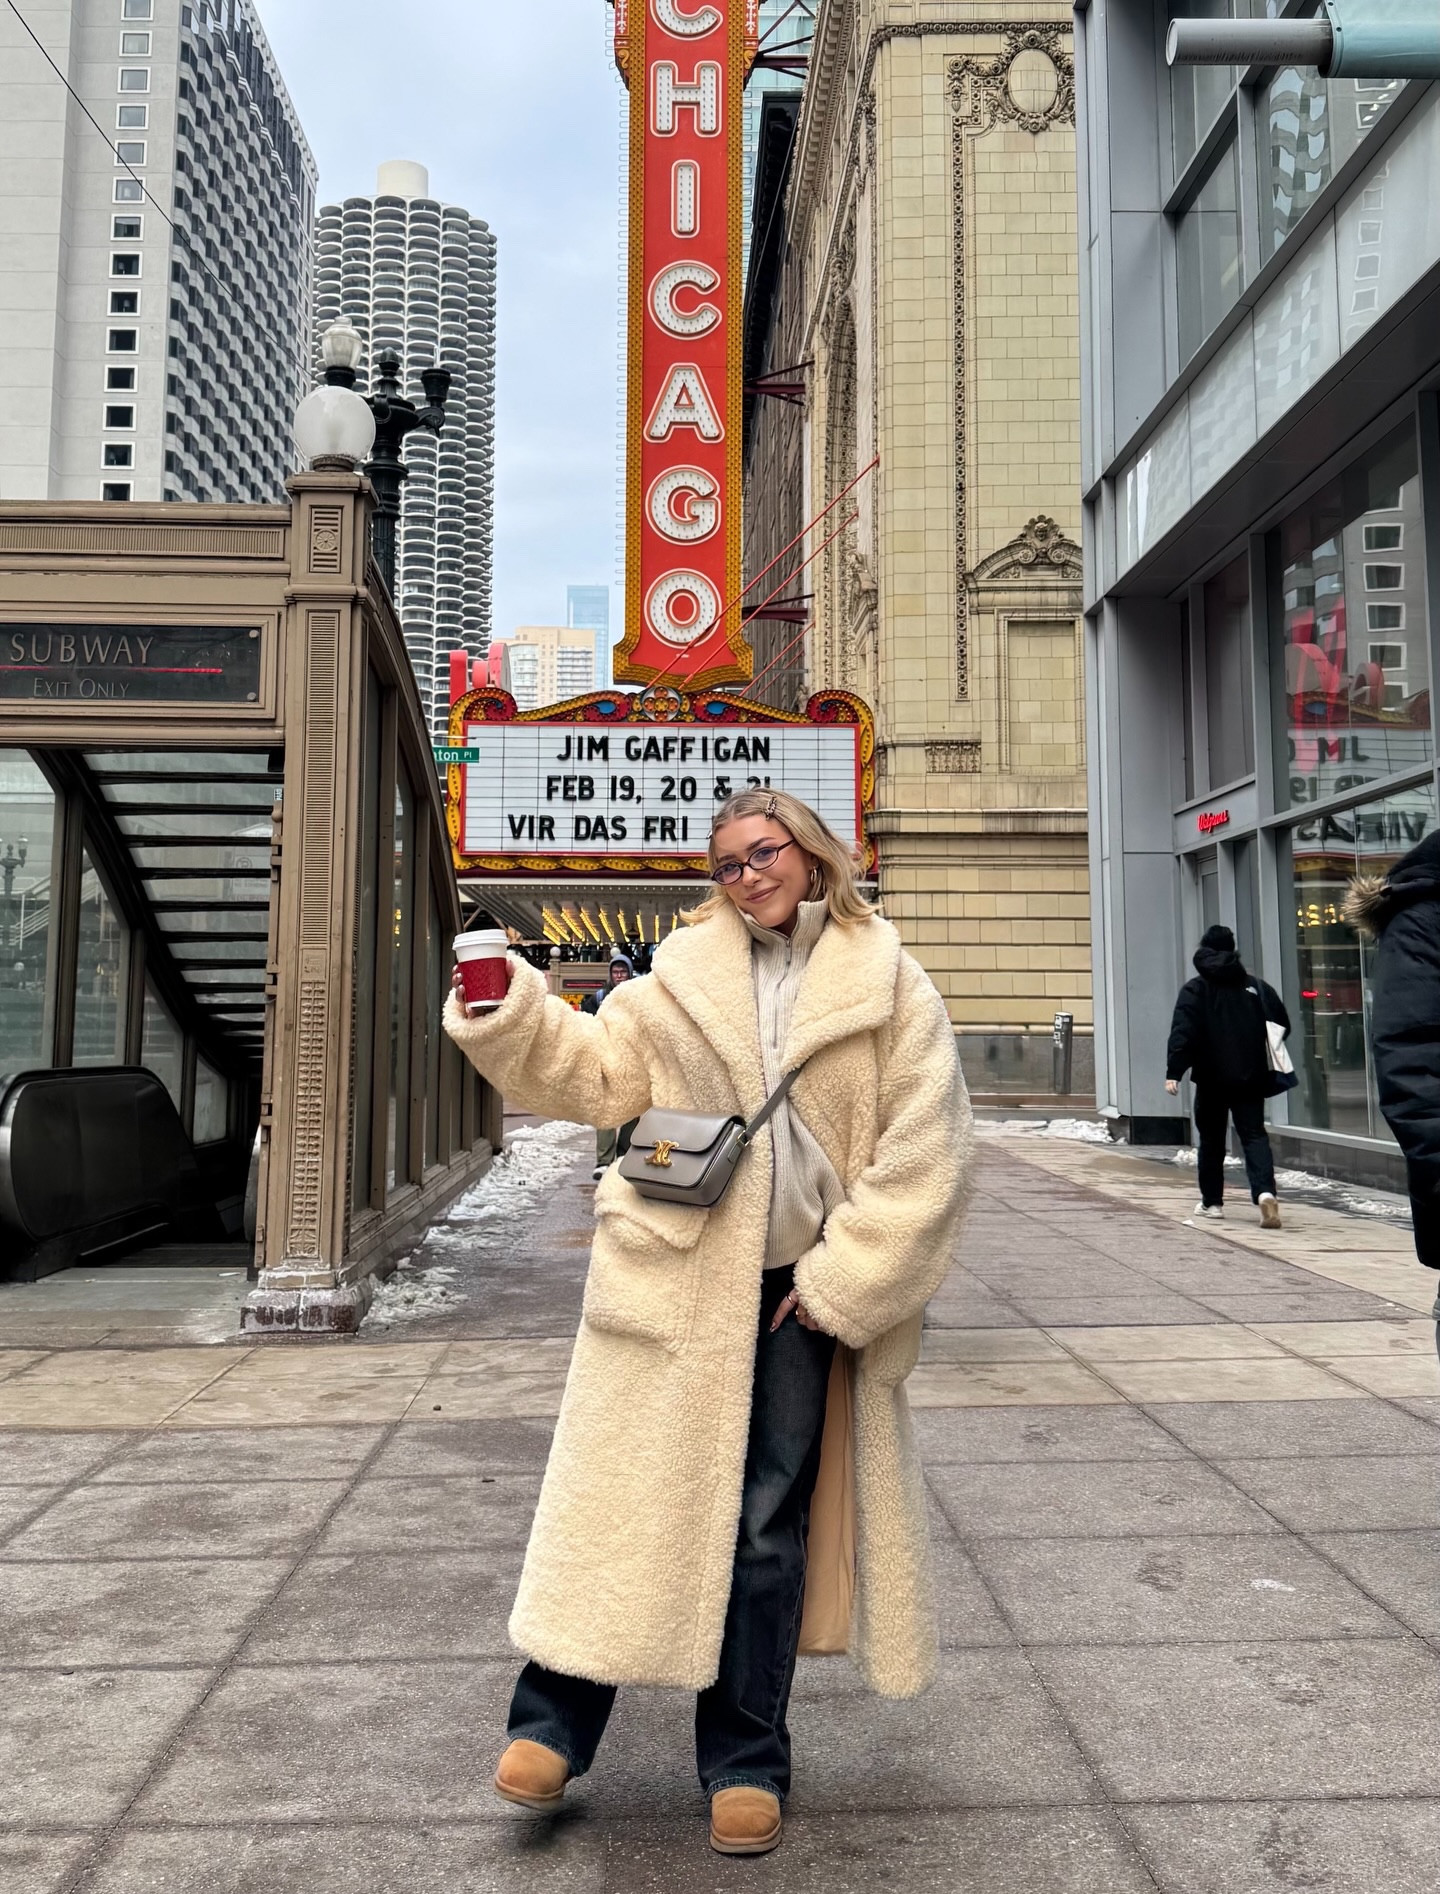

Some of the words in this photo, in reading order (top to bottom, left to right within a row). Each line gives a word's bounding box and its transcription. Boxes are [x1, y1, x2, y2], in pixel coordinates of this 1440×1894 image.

[643, 0, 725, 650] CHICAGO
[10, 633, 154, 664] SUBWAY
[34, 678, 71, 697] EXIT
[79, 678, 130, 698] ONLY
[556, 735, 609, 762] JIM
[625, 736, 770, 762] GAFFIGAN
[546, 775, 595, 802] FEB
[607, 775, 645, 804] 19,
[660, 775, 697, 802] 20
[713, 775, 733, 801] &
[507, 815, 555, 841] VIR
[574, 815, 627, 841] DAS
[643, 815, 688, 841] FRI
